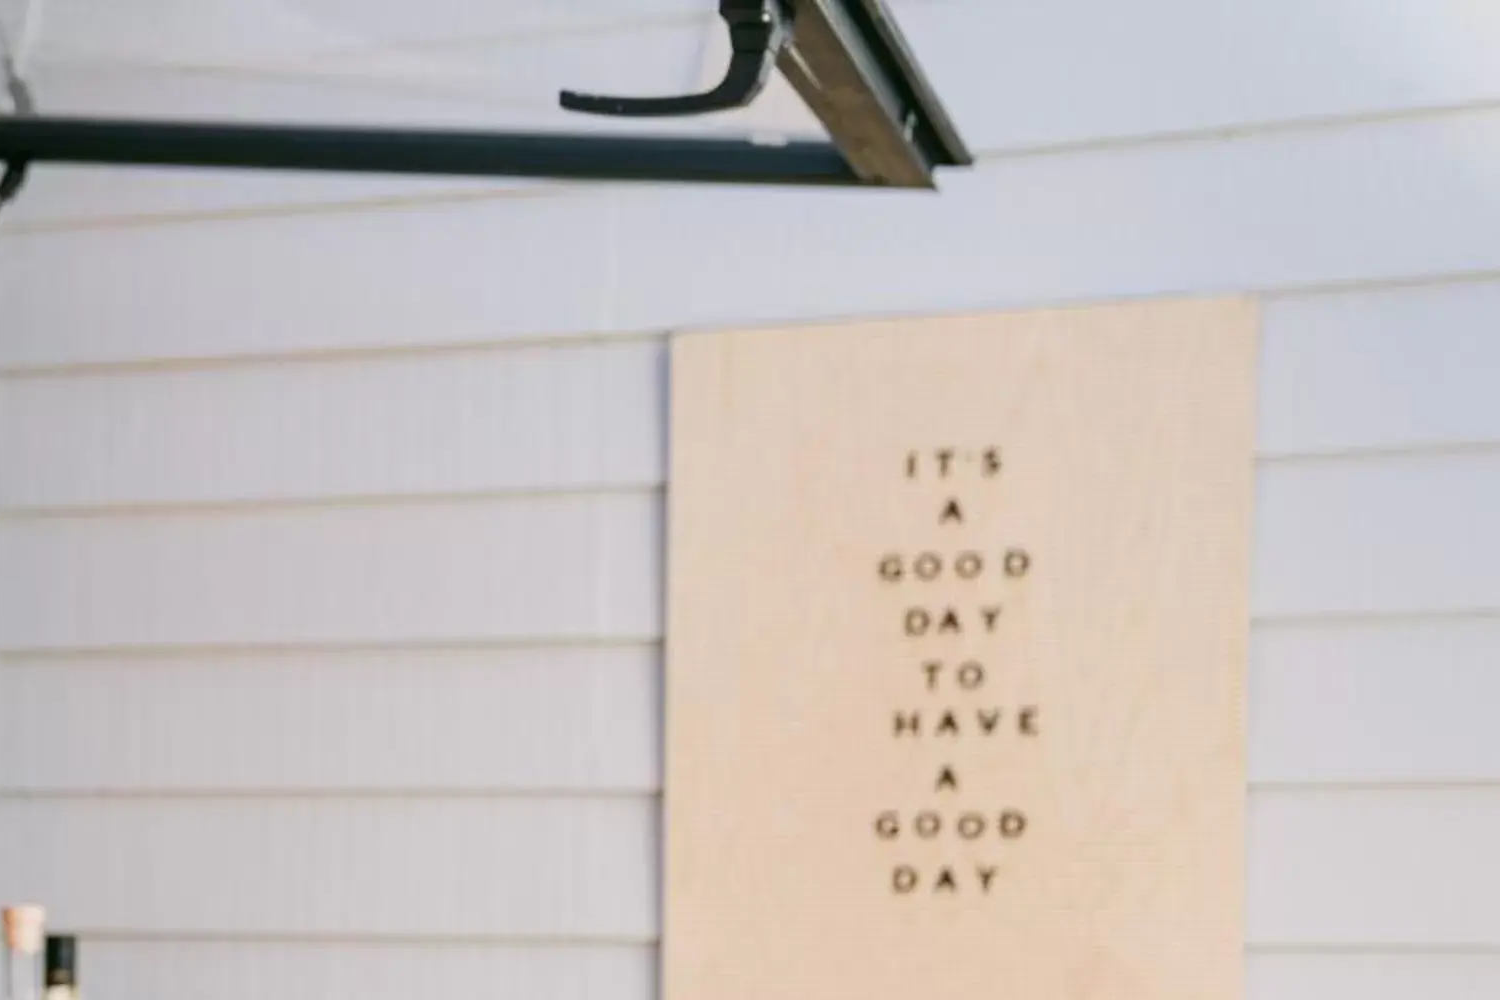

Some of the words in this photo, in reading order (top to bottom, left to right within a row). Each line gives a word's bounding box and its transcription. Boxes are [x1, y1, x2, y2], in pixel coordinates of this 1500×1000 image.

[938, 498, 964, 525] A
[876, 550, 1032, 584] GOOD
[904, 607, 1002, 637] DAY
[922, 661, 986, 690] TO
[892, 706, 1039, 737] HAVE
[934, 764, 959, 792] A
[873, 810, 1028, 841] GOOD
[891, 865, 998, 895] DAY
